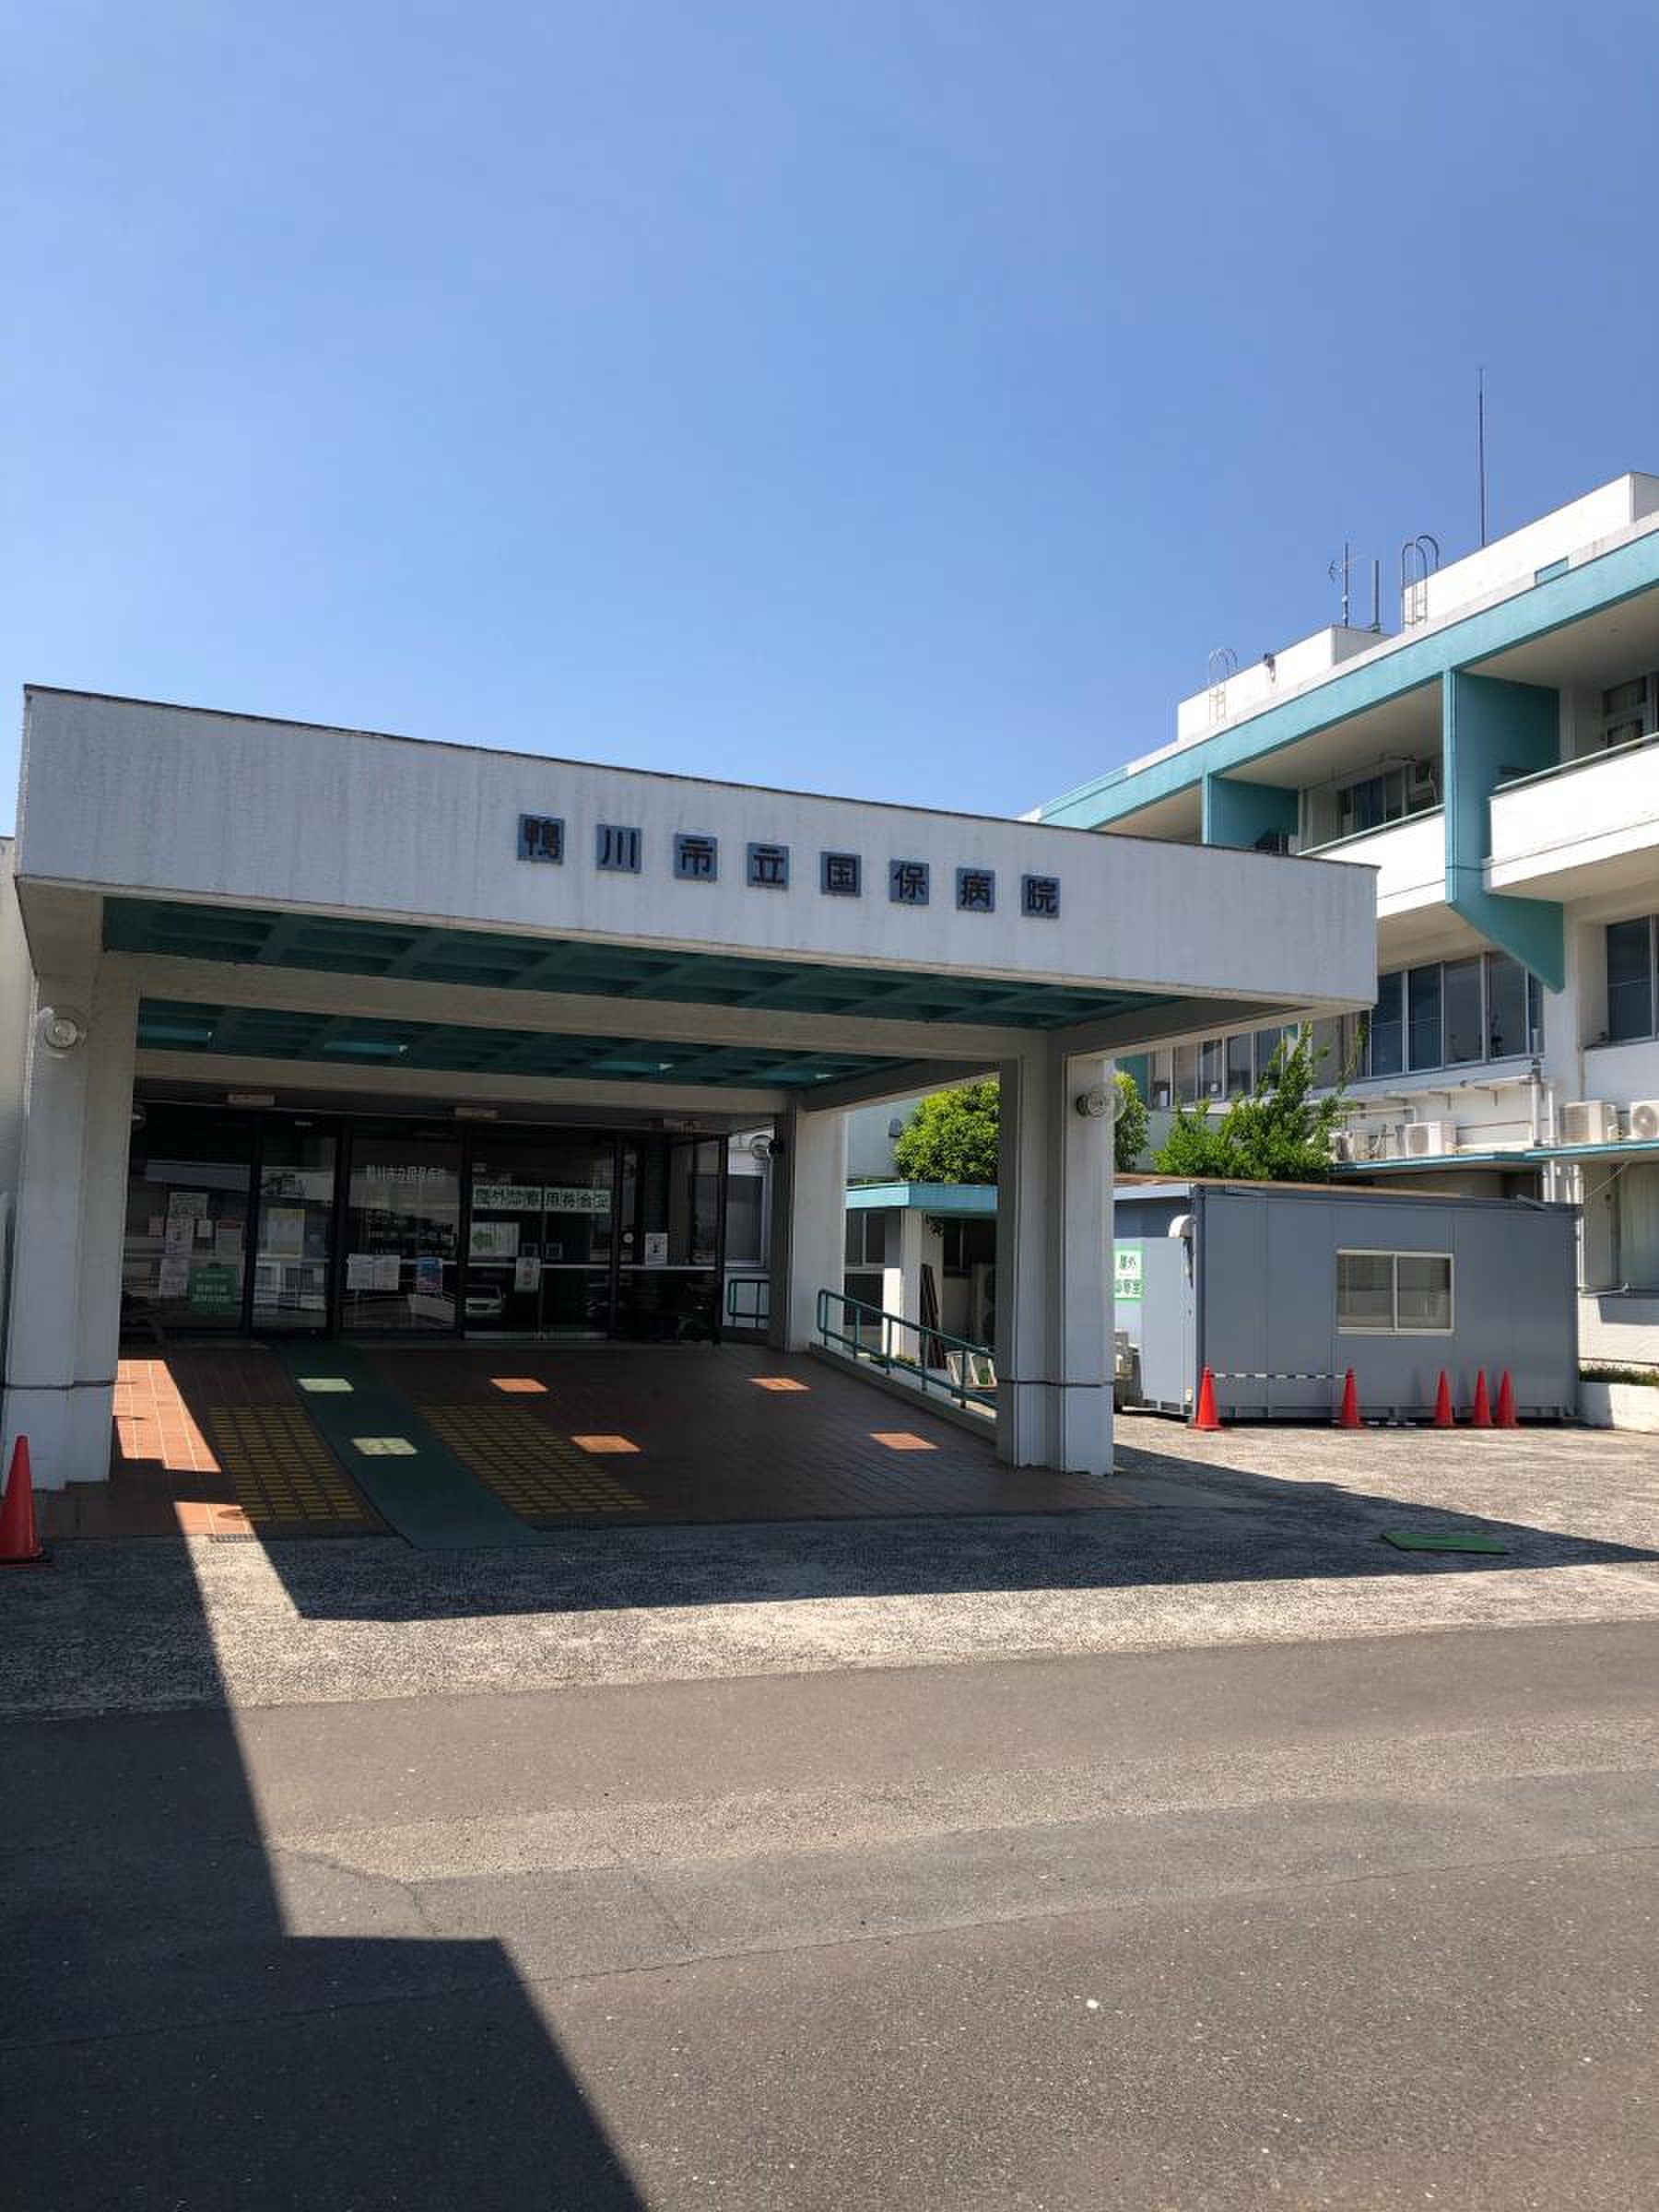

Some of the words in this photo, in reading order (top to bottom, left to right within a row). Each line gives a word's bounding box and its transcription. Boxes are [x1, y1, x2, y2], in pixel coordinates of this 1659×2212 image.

[524, 818, 1058, 913] 鴨川市立国保病院
